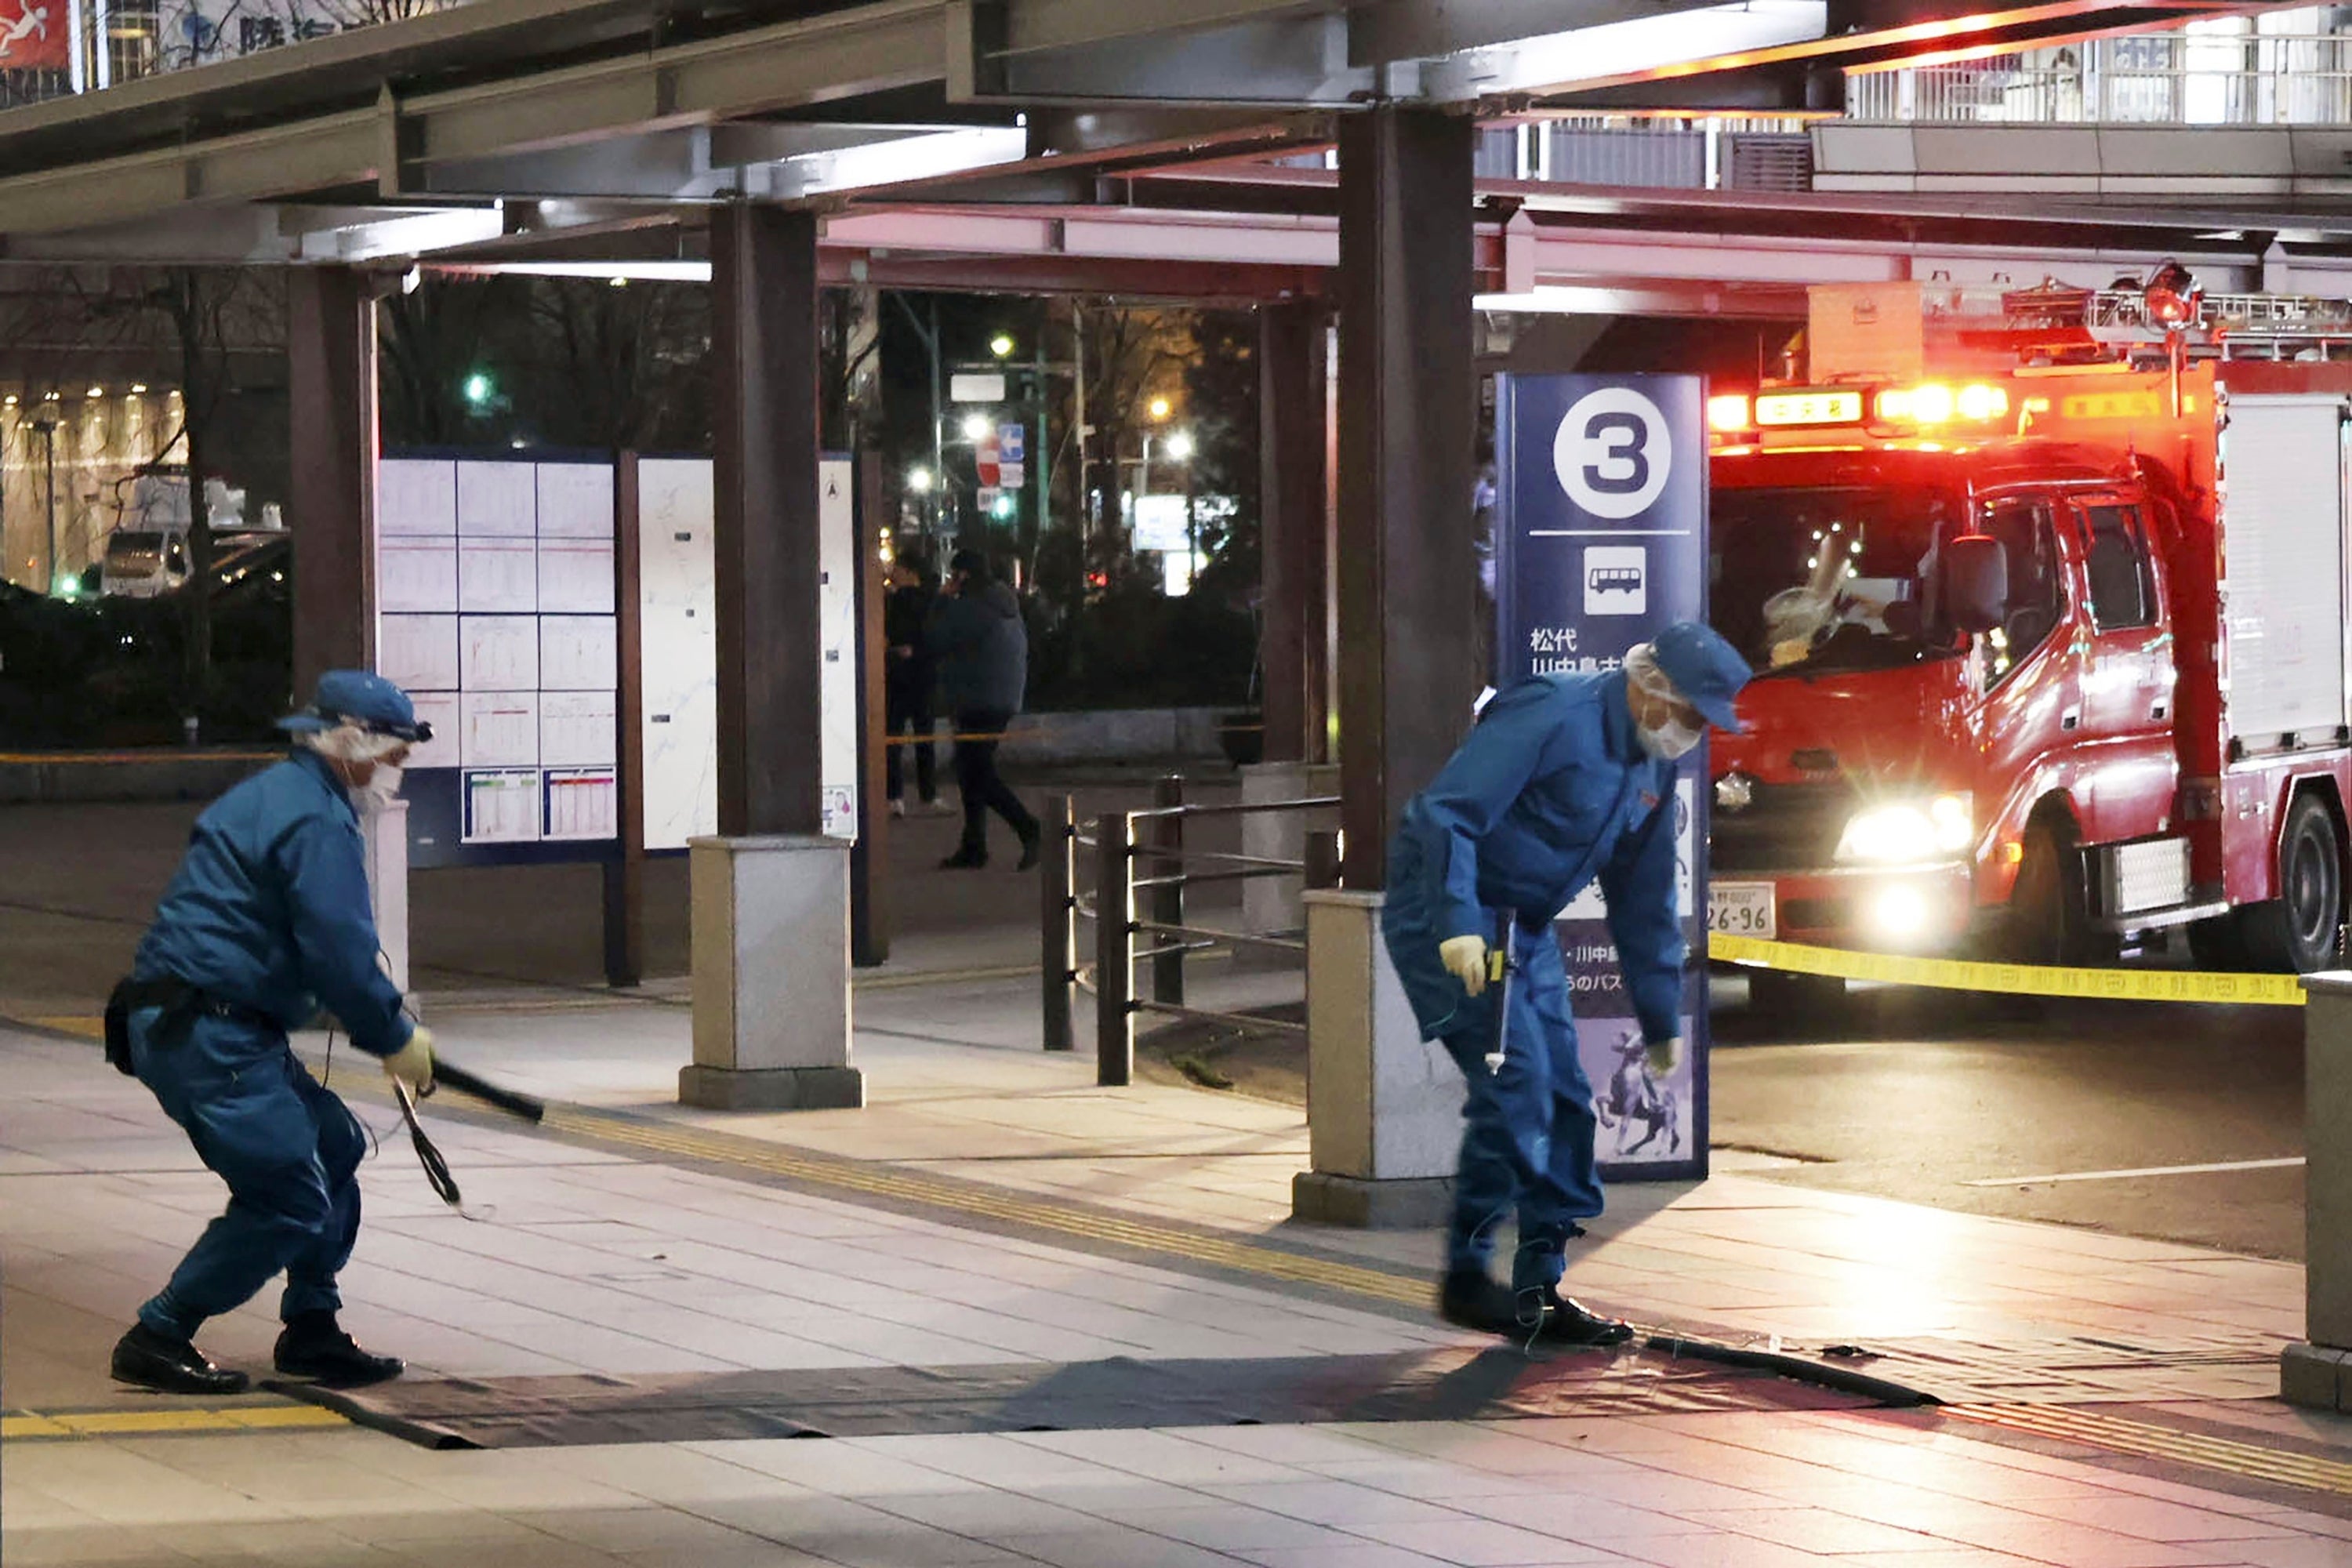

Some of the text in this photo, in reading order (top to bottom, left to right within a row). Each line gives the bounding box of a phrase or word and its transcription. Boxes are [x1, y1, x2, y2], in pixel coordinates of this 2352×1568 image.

[1583, 412, 1649, 494] 3
[1530, 628, 1577, 652] 松代
[1532, 656, 1627, 675] 川中島古
